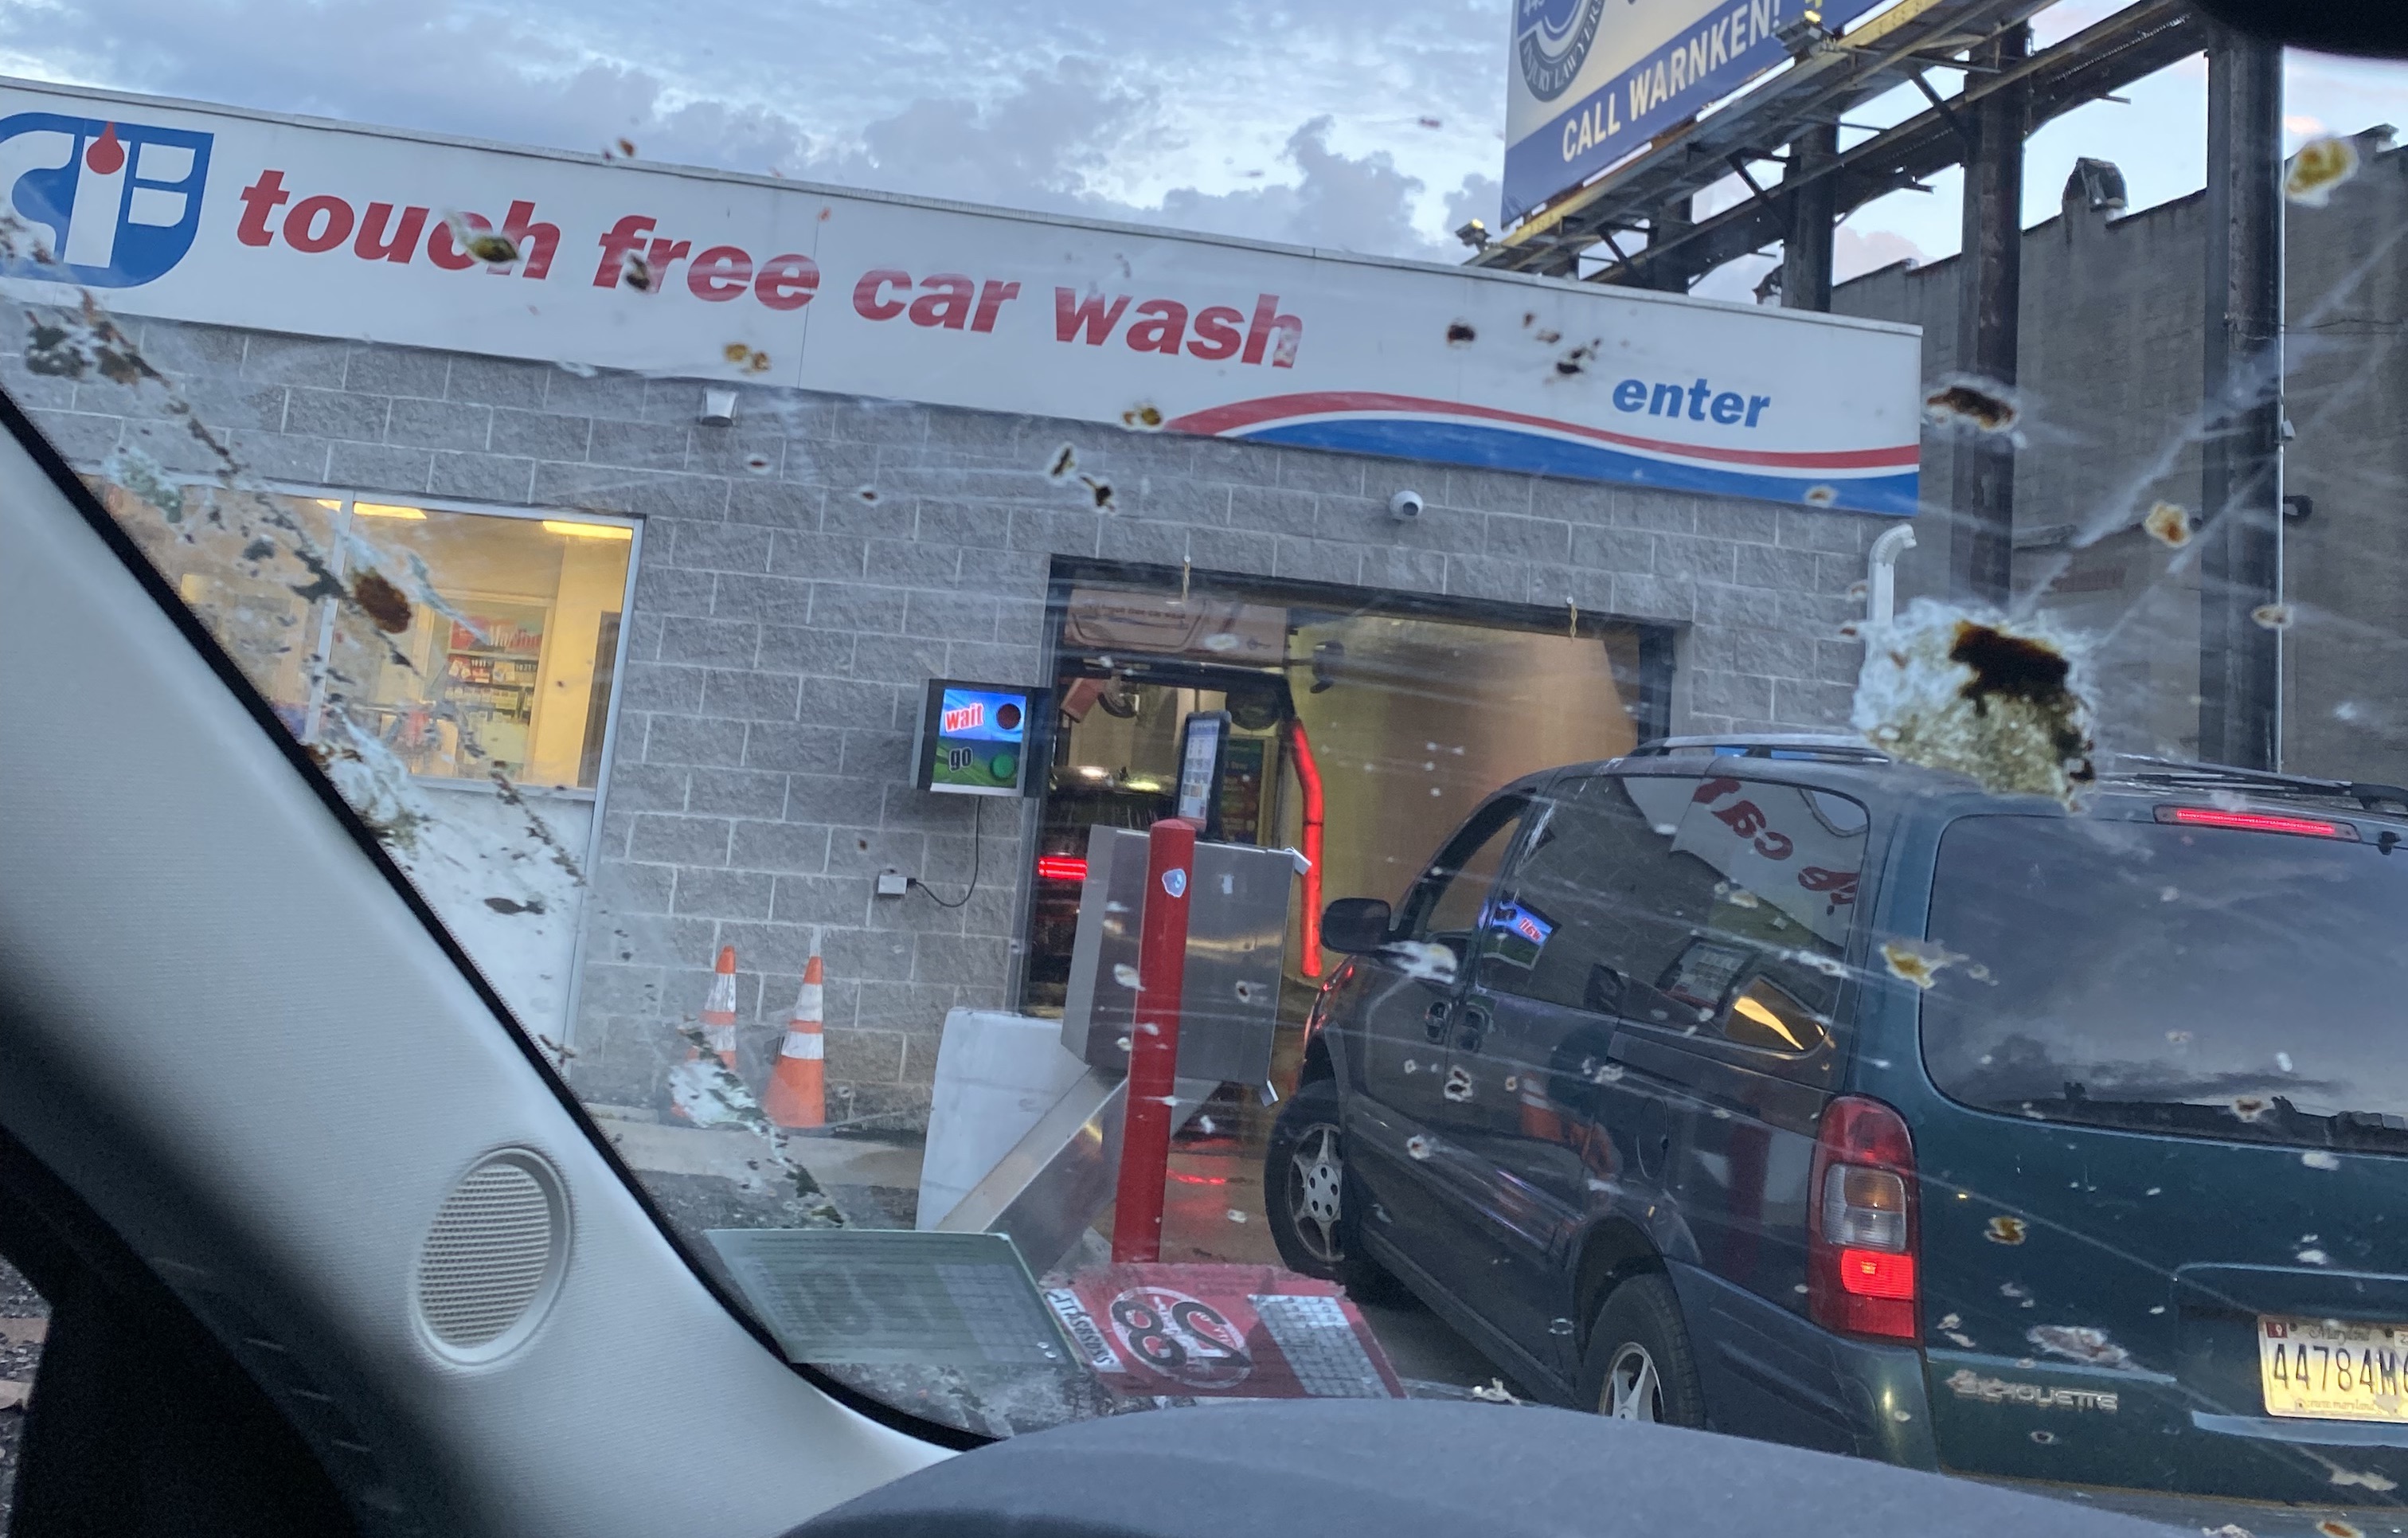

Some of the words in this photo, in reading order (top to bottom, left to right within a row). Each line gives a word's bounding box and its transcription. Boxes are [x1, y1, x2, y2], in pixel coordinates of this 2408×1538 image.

[1562, 92, 1621, 163] CALL
[1629, 0, 1781, 122] WARNKEN!
[237, 170, 561, 280] touch
[592, 215, 820, 311] free
[852, 268, 1022, 333] car
[1054, 286, 1303, 369] wash
[1612, 378, 1771, 428] enter
[945, 702, 984, 733] wait
[949, 746, 973, 773] go
[1954, 1375, 2118, 1412] OUETTE
